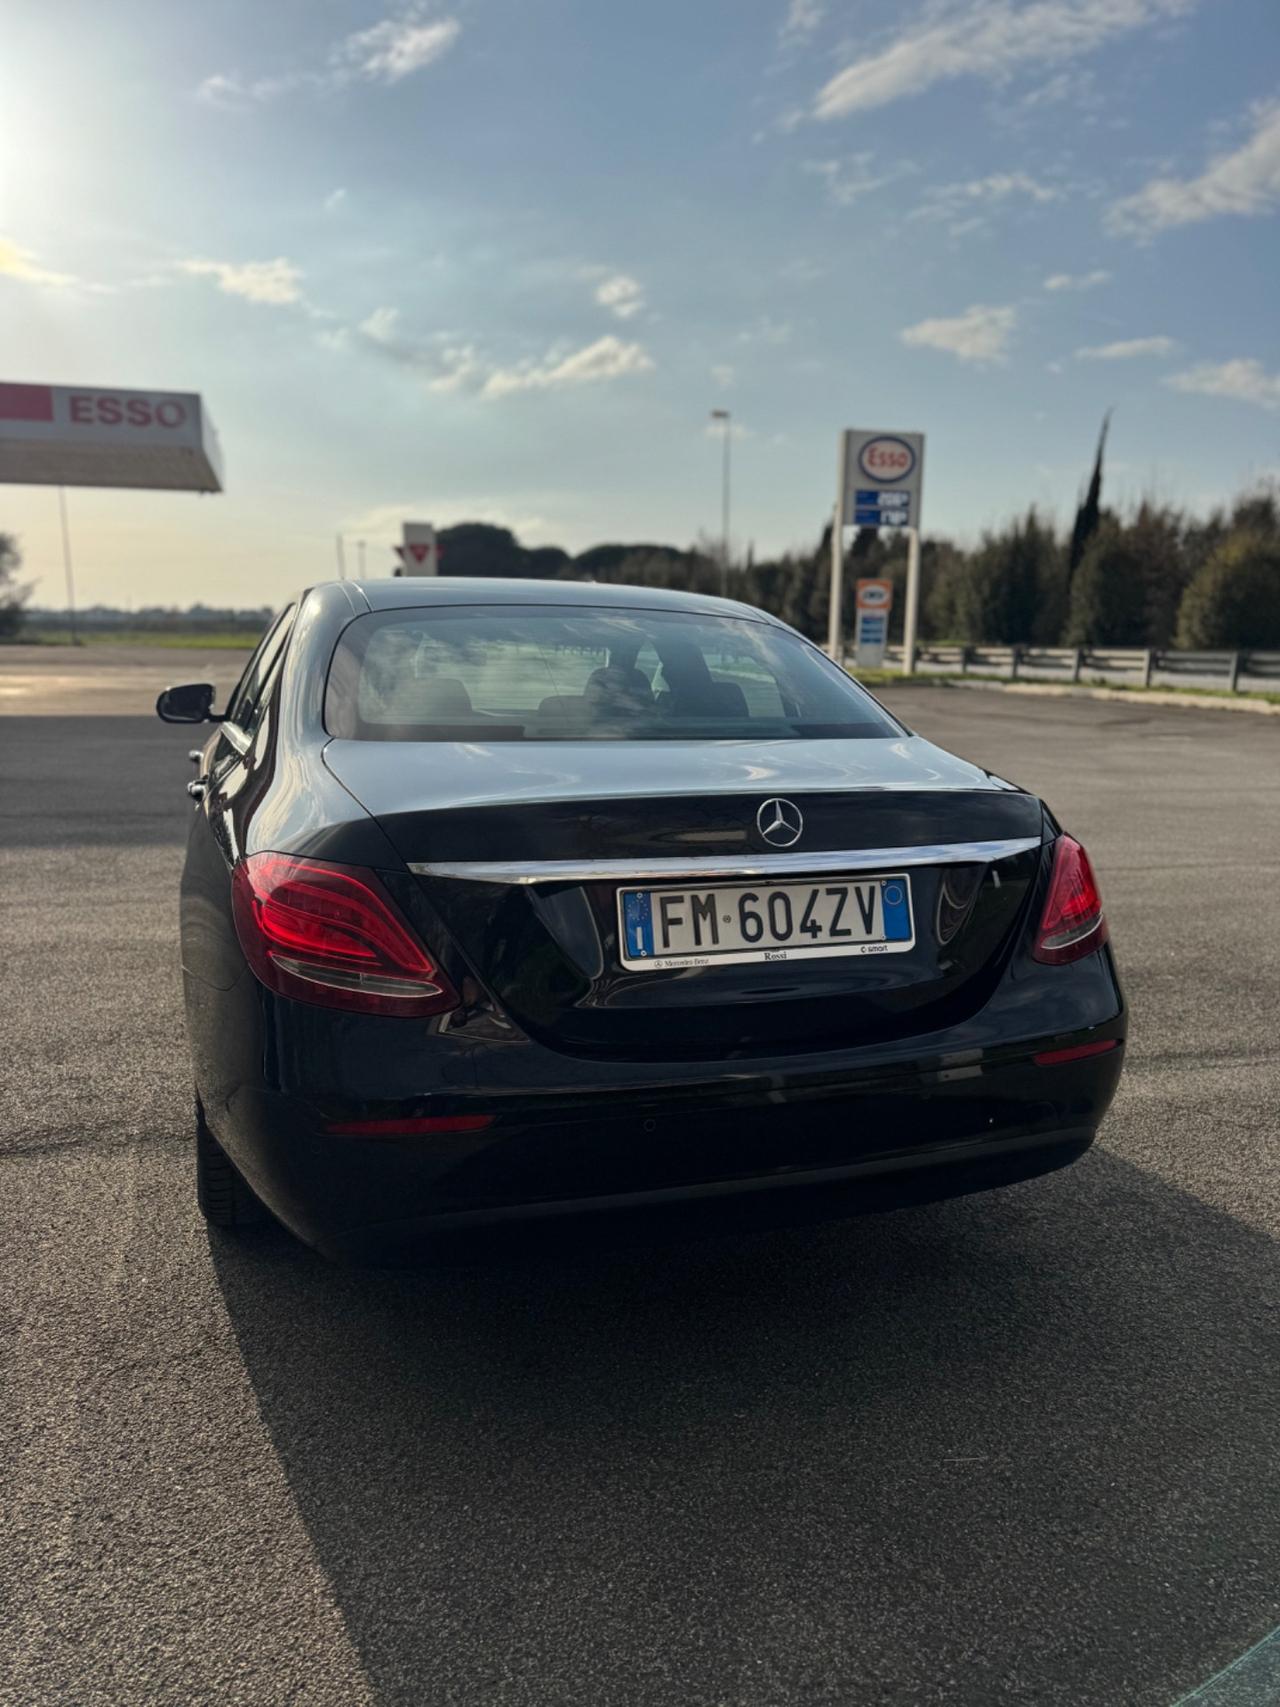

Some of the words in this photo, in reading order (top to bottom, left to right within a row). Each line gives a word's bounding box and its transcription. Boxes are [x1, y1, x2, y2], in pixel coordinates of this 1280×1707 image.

[69, 396, 187, 428] ESSO
[868, 447, 908, 468] Esso
[660, 893, 719, 948] FM
[738, 885, 876, 943] 604ZV
[764, 951, 787, 961] Rossi
